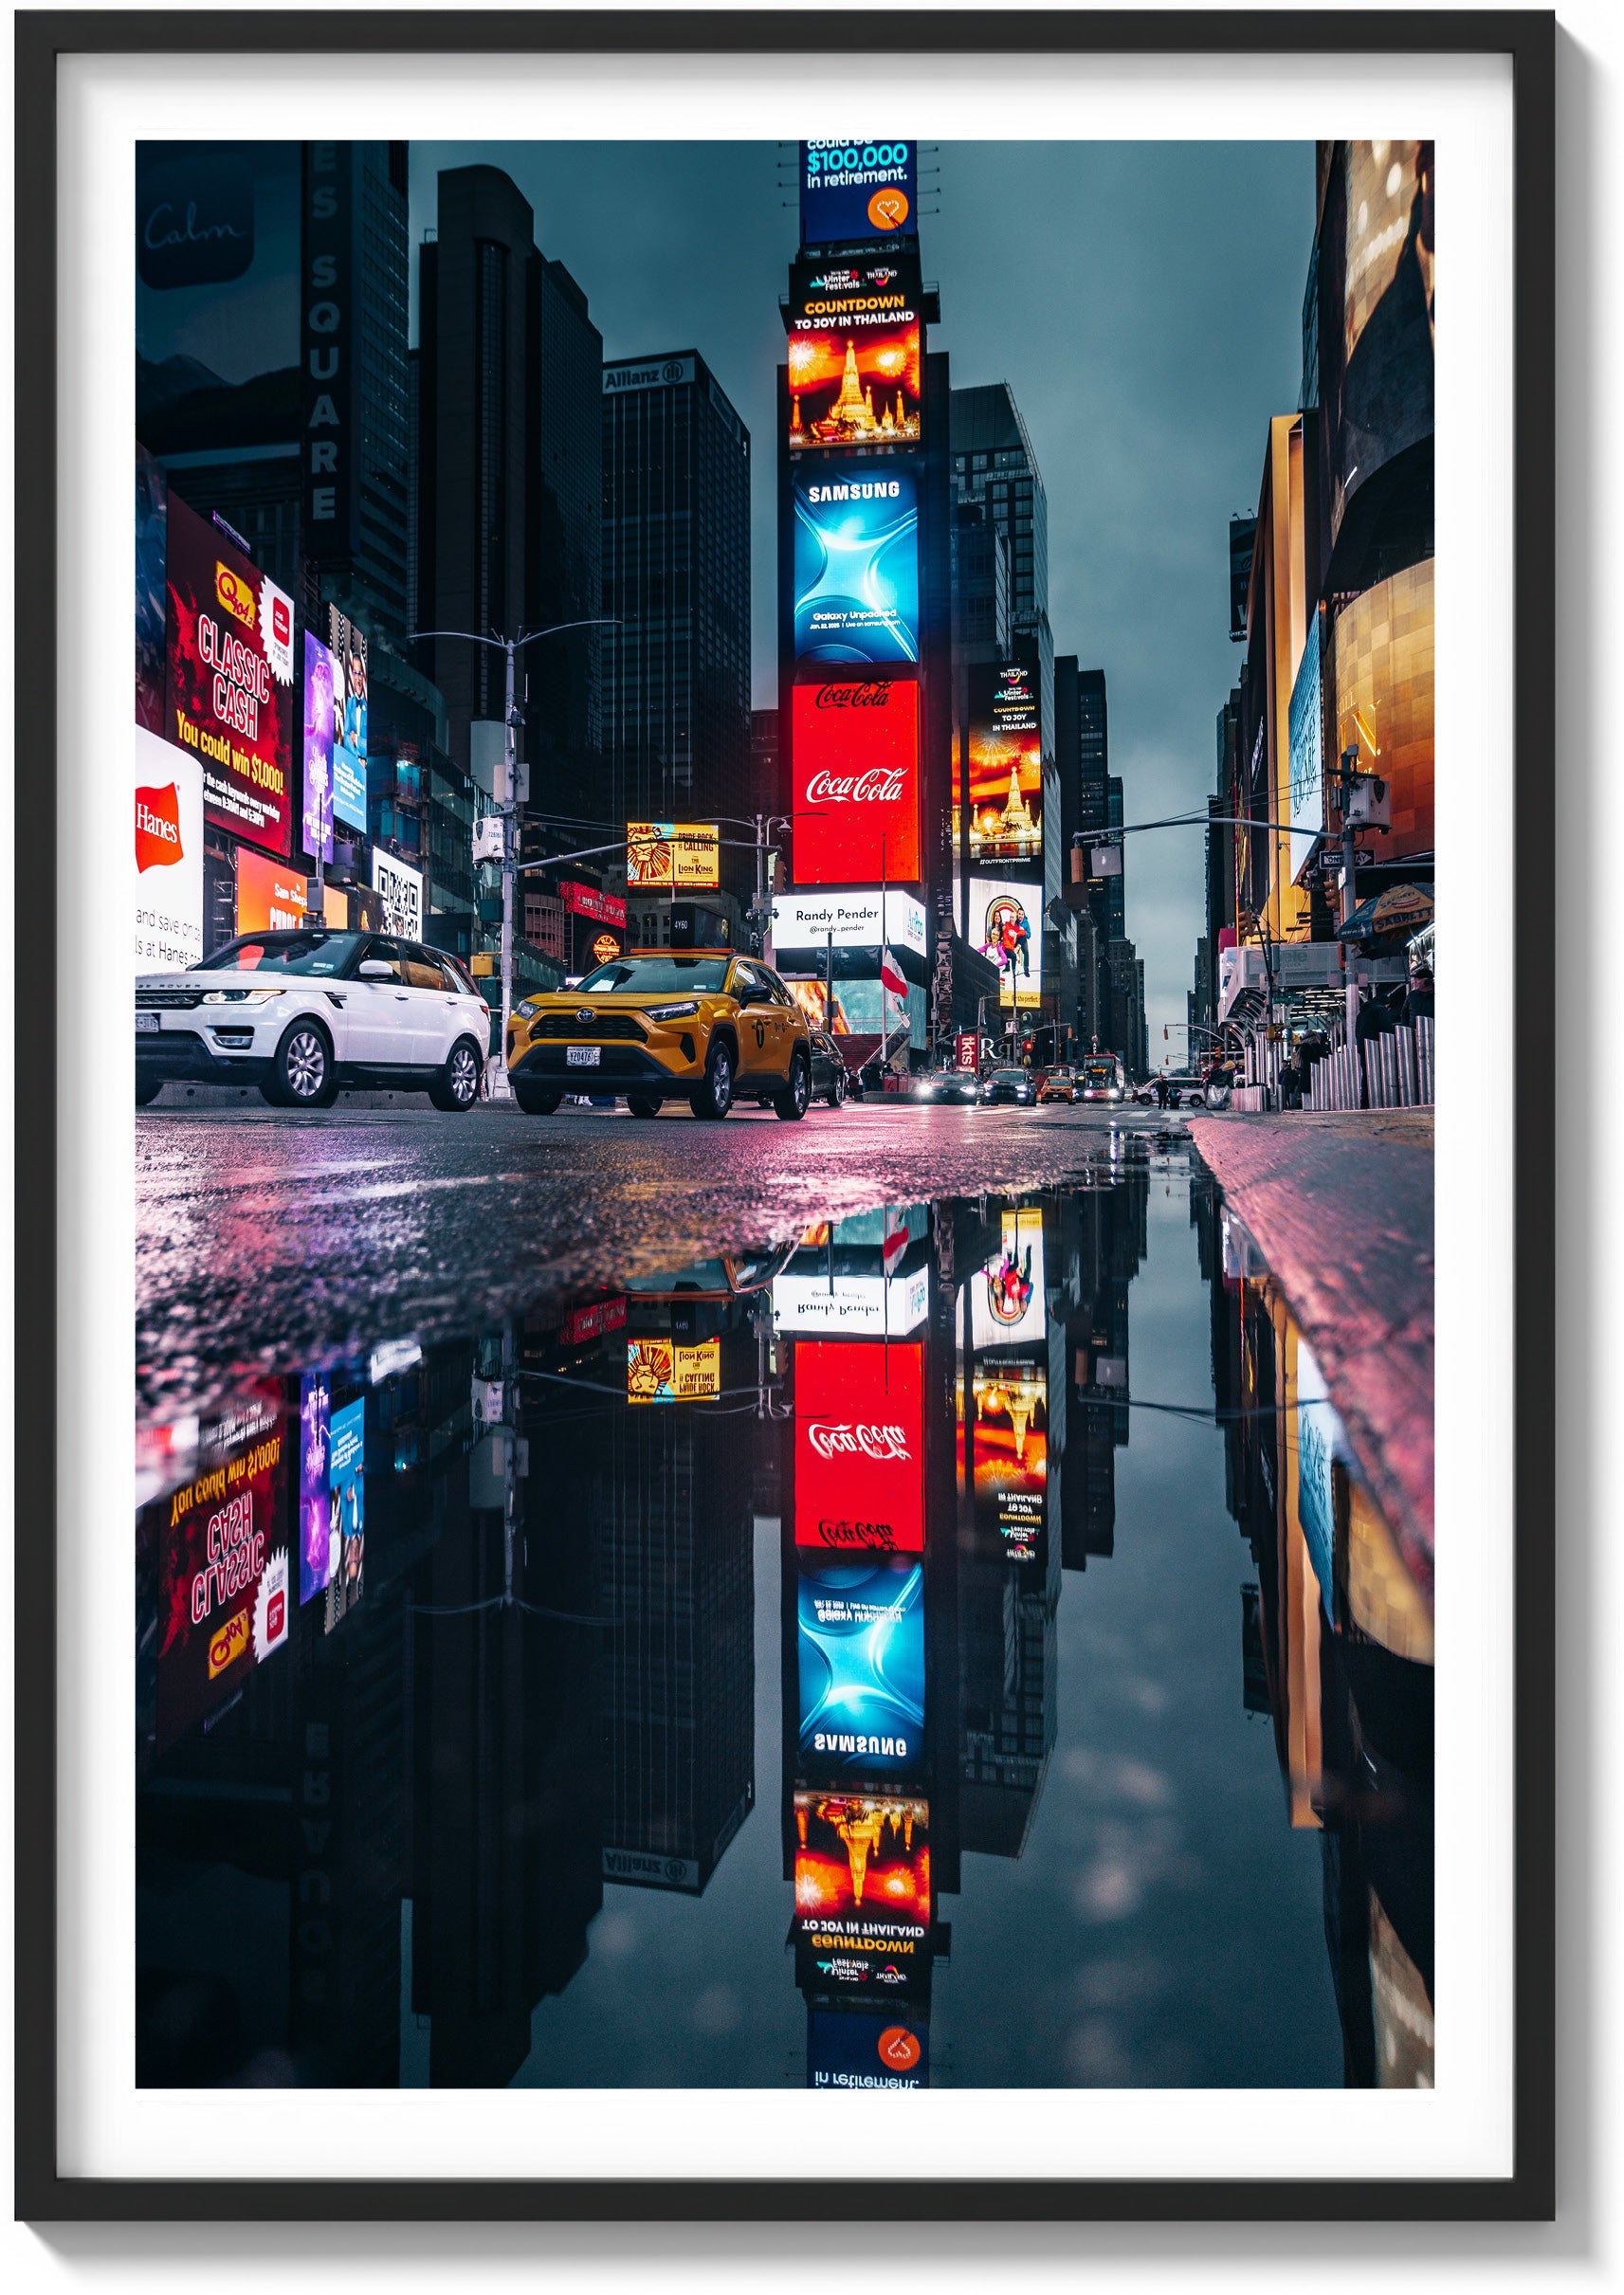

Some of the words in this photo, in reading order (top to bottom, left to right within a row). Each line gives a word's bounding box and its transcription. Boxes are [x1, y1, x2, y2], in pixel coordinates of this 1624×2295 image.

[808, 143, 908, 174] $100,000
[807, 173, 821, 189] in
[824, 166, 907, 188] retirement.
[143, 200, 246, 250] Calm
[825, 279, 860, 291] Festivals
[805, 294, 905, 315] COUNTDOWN
[794, 319, 812, 330] TO
[814, 317, 837, 329] JOY
[839, 315, 852, 327] IN
[853, 311, 915, 325] THAILAND
[307, 254, 341, 521] SQUARE
[605, 369, 660, 390] Allianz
[809, 481, 900, 503] SAMSUNG
[812, 611, 848, 622] Galaxy
[849, 609, 897, 621] Unpacked
[199, 614, 270, 704] CLASSIC
[213, 674, 258, 741] CASH
[1001, 722, 1036, 731] THAILAND
[176, 709, 199, 749] You
[200, 731, 230, 767] could
[231, 747, 250, 777] win
[251, 753, 283, 796] $1,000!
[806, 767, 909, 803] Coca-Cola
[137, 803, 177, 844] Hanes
[274, 883, 289, 900] Sam
[136, 908, 155, 928] and
[158, 915, 179, 935] save
[674, 920, 688, 930] 4Y60
[795, 908, 833, 922] Randy
[837, 907, 879, 920] Pender
[809, 924, 865, 935] @randy_pender
[146, 940, 155, 958] at
[961, 1036, 976, 1066] tkts
[979, 1037, 1001, 1060] R
